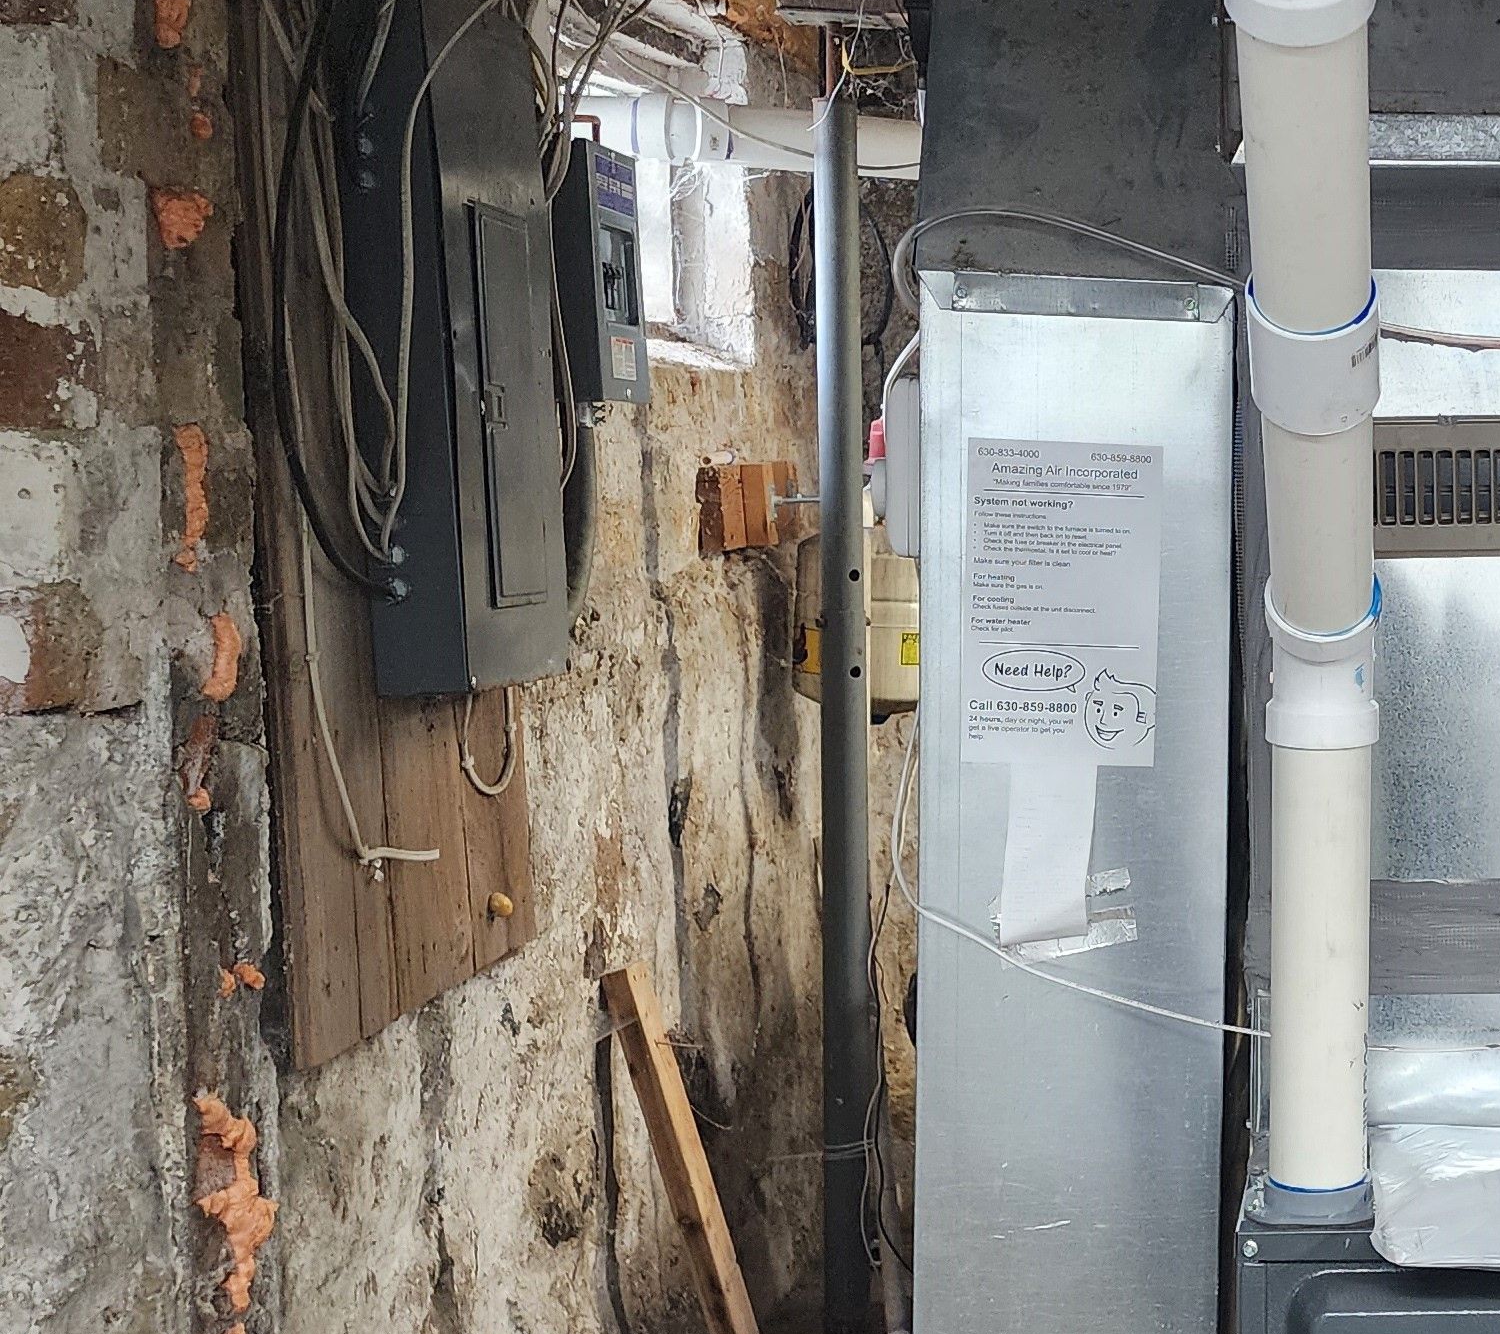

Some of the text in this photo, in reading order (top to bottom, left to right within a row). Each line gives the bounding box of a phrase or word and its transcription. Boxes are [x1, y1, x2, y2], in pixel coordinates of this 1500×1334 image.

[977, 447, 1040, 459] 630-833-4000
[991, 462, 1138, 480] Amazing Air Incorporated
[1022, 479, 1049, 488] families
[1050, 481, 1090, 490] comfortable
[974, 496, 1073, 510] System not working?
[988, 573, 1015, 582] heating
[994, 662, 1072, 681] Need Help?
[969, 699, 1077, 713] Call 630-859-8800
[1005, 716, 1018, 725] day
[1048, 719, 1061, 727] you
[1001, 725, 1030, 734] operator
